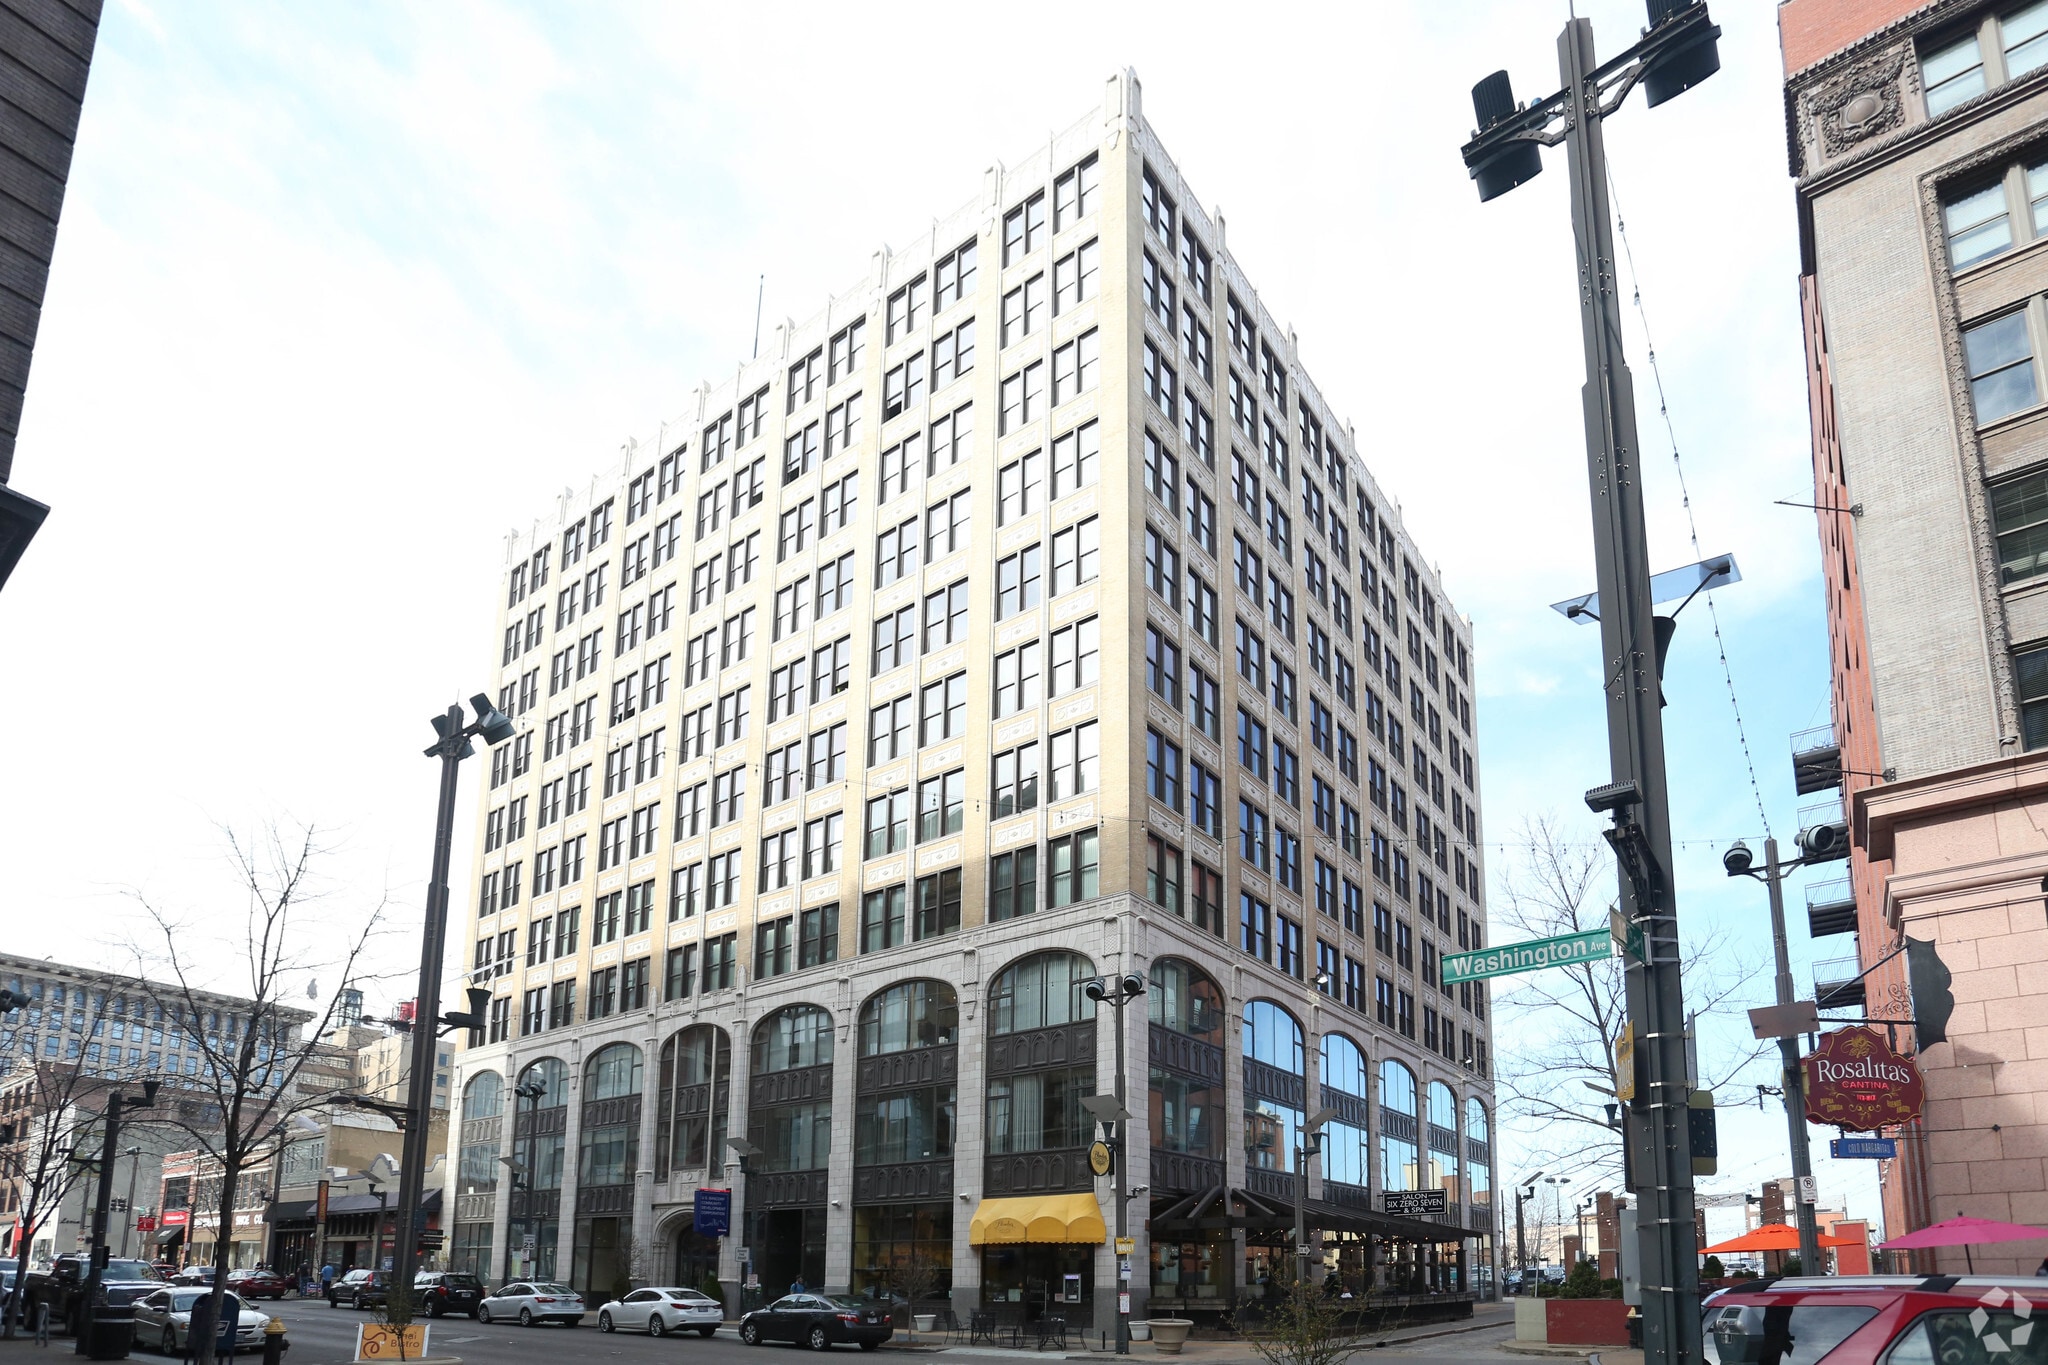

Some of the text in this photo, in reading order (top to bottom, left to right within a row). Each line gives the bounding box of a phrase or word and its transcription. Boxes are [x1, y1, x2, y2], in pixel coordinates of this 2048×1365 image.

[1452, 940, 1607, 976] Washington Ave
[1816, 1055, 1910, 1083] Rosalita's
[1841, 1080, 1889, 1090] CANTINA
[1848, 1143, 1891, 1154] COLD MARGARITAS
[1387, 1199, 1443, 1209] SIX ZERO SEVEN
